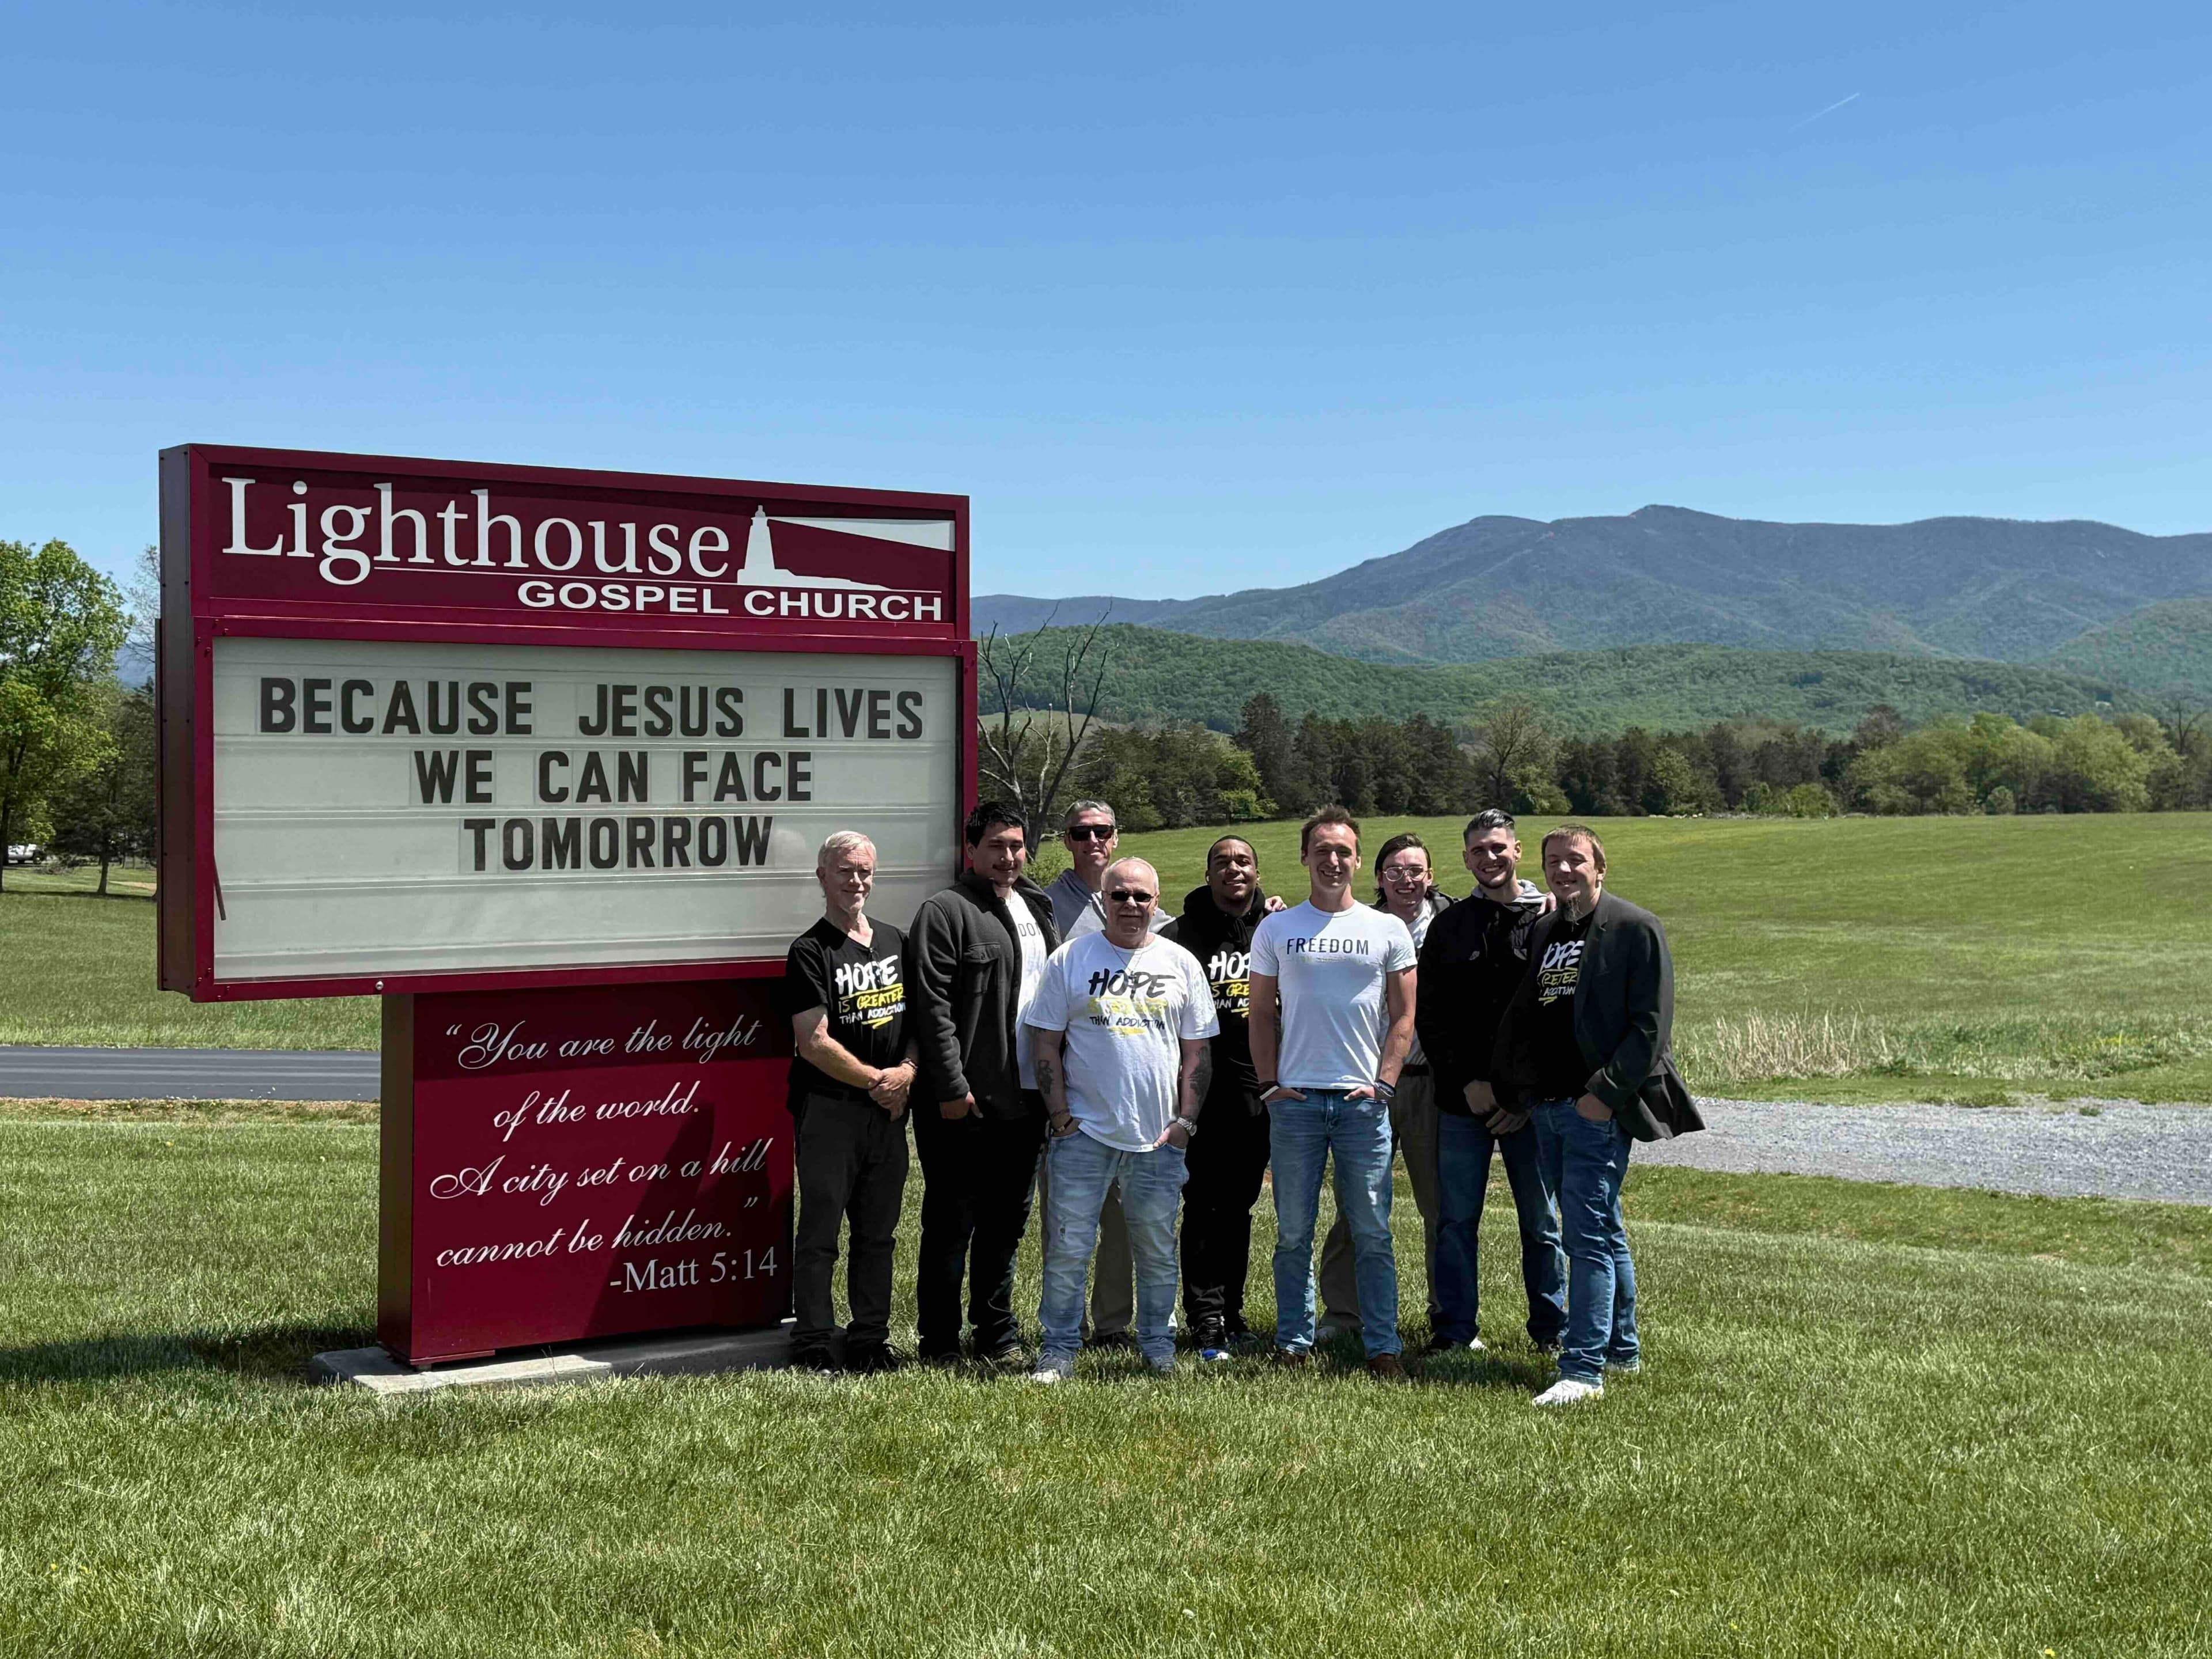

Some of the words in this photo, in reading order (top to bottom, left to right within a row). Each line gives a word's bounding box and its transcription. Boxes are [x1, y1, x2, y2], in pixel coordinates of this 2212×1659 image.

[222, 477, 730, 585] Lighthouse
[517, 580, 729, 615] GOSPEL
[744, 590, 942, 621] CHURCH
[260, 677, 533, 736] BECAUSE
[579, 684, 744, 738] JESUS
[784, 687, 923, 740] LIVES
[416, 751, 493, 804] WE
[539, 751, 649, 803] CAN
[683, 751, 811, 802] FACE
[464, 816, 774, 872] TOMORROW
[1287, 938, 1369, 955] FREEDOM
[835, 955, 899, 995] HOPE
[1088, 968, 1176, 999] HOPE
[1211, 985, 1220, 997] S
[839, 1000, 850, 1013] IS
[857, 987, 906, 1010] GREATER
[559, 1036, 615, 1057] are
[624, 1019, 673, 1054] the
[682, 1014, 763, 1064] light
[493, 1090, 540, 1142] of
[536, 1089, 586, 1124] the
[596, 1080, 700, 1120] world.
[430, 1155, 506, 1199] A
[503, 1162, 569, 1206] city
[576, 1157, 624, 1186] set
[628, 1165, 671, 1183] on
[680, 1158, 702, 1177] a
[709, 1138, 774, 1175] hill
[436, 1228, 565, 1267] cannot
[568, 1219, 604, 1253] be
[610, 1256, 700, 1294] -Matt
[710, 1247, 778, 1284] 5:14
